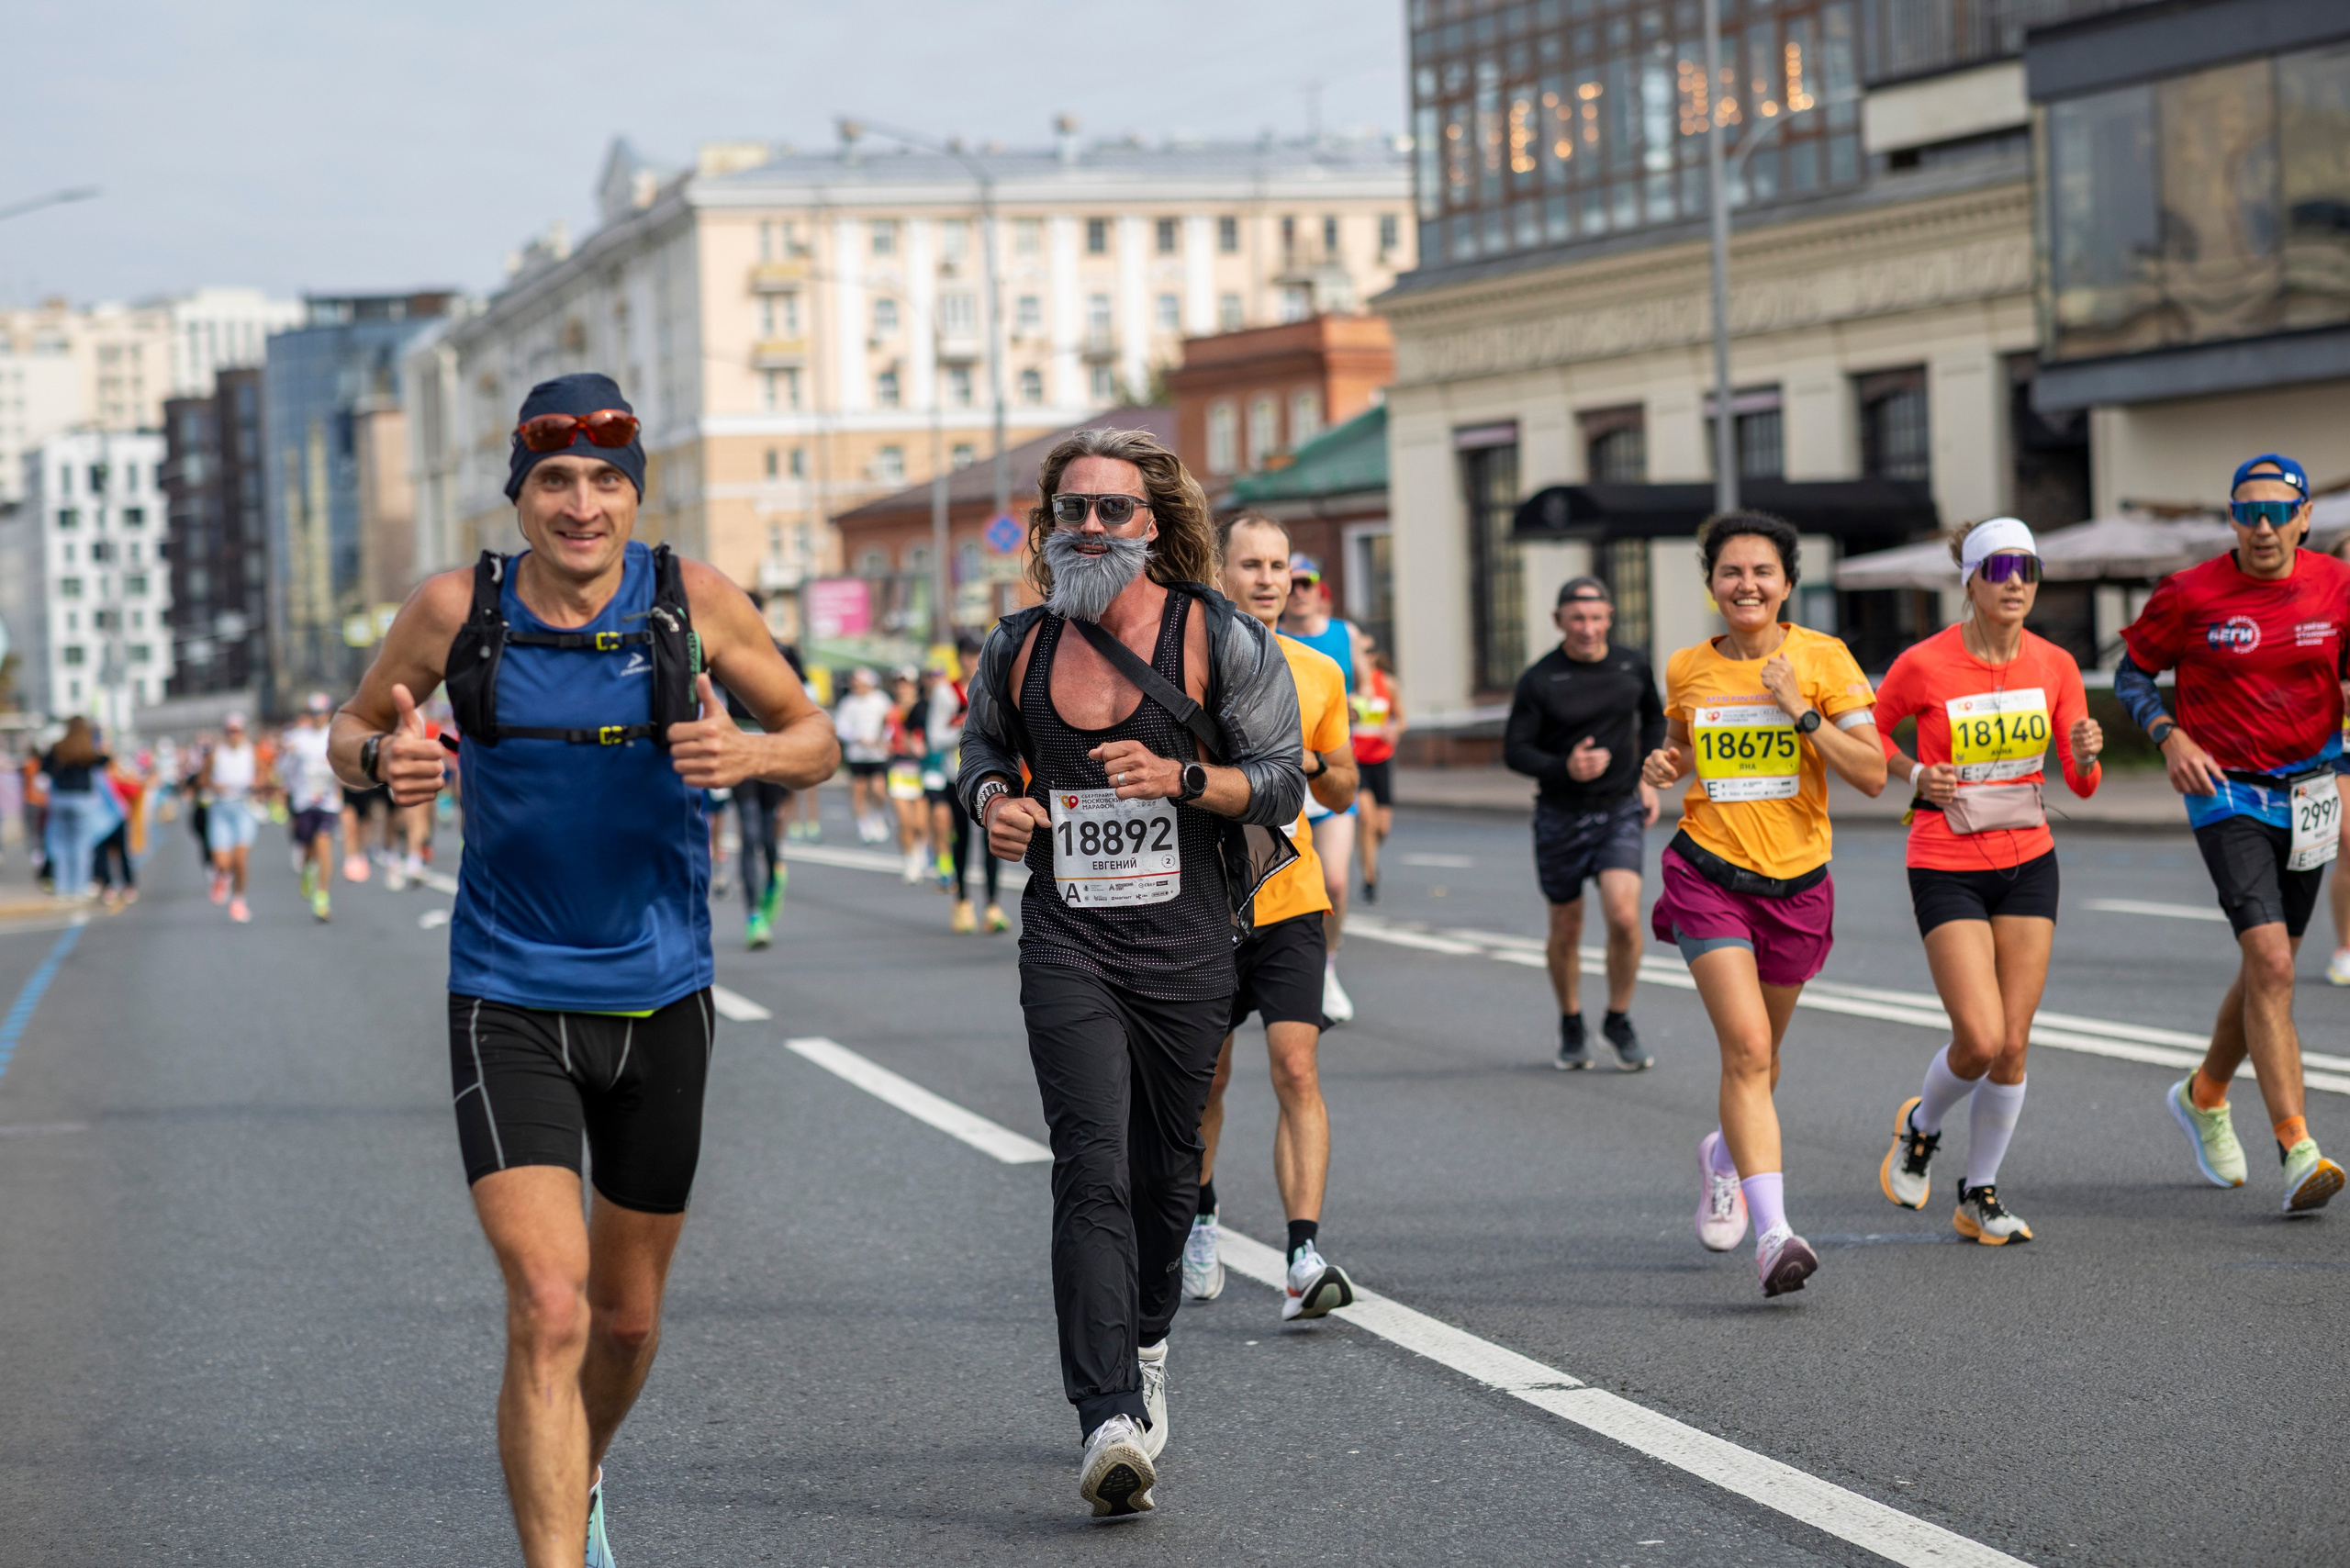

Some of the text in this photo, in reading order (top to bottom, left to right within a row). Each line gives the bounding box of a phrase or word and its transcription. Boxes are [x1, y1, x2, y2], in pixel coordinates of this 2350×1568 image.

[1706, 695, 1729, 703] MTS
[1700, 731, 1796, 760] 18675
[1957, 714, 2046, 749] 18140
[2300, 796, 2339, 833] 2997
[1058, 816, 1173, 857] 18892
[1092, 857, 1137, 870] ЕВГЕНИЙ
